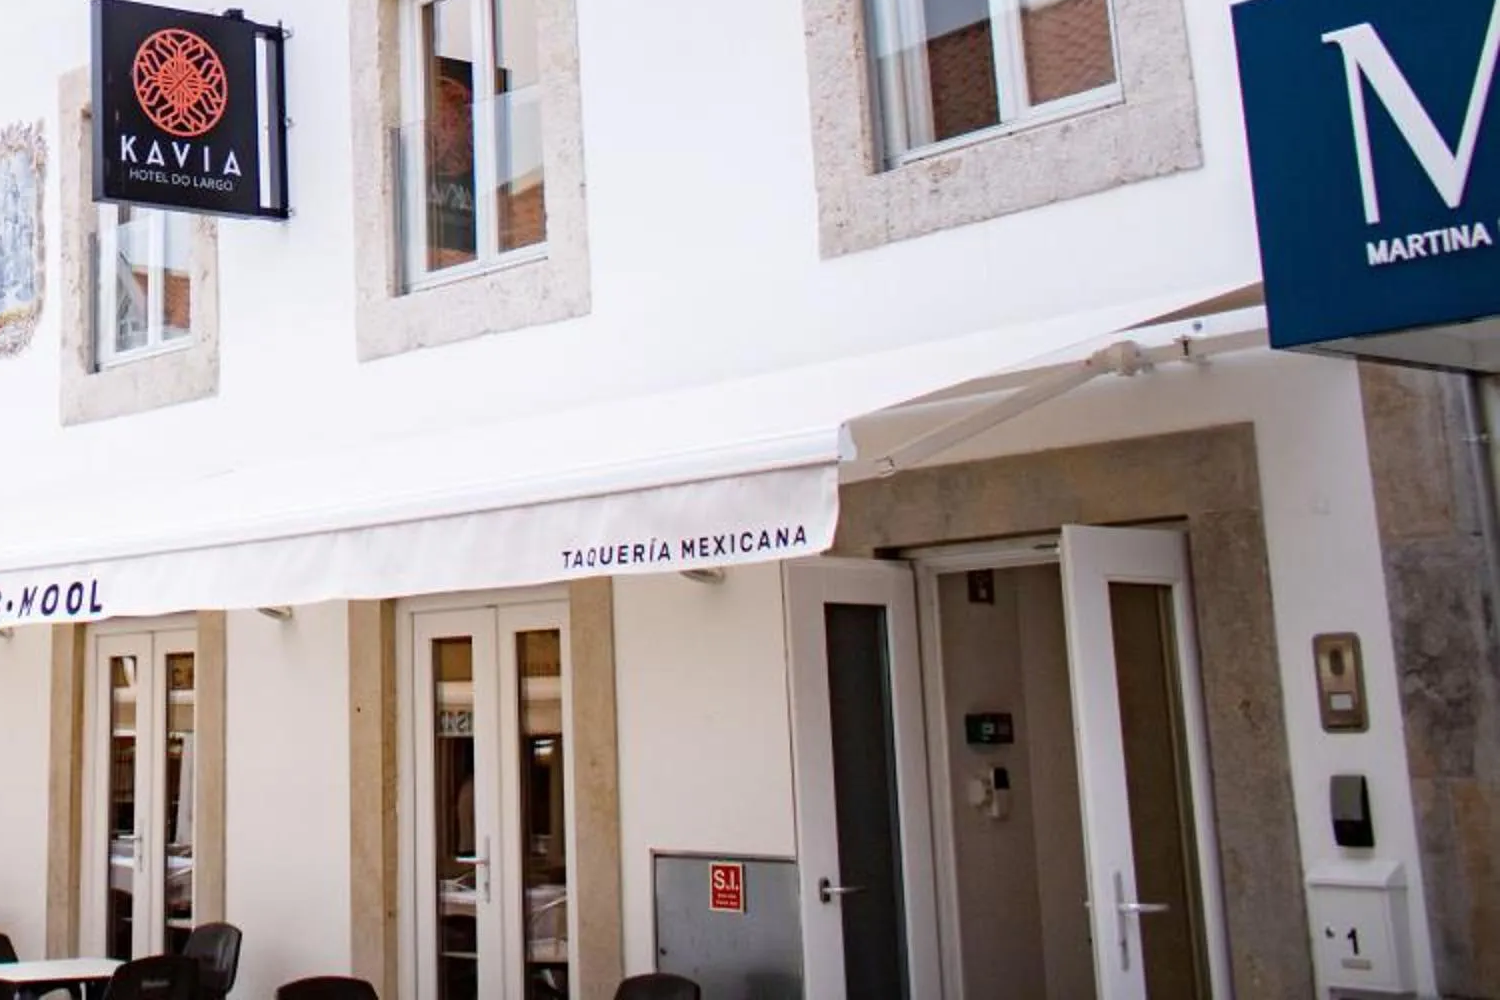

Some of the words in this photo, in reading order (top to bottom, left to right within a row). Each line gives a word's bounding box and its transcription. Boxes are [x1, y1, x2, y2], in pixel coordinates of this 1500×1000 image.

[120, 134, 242, 177] KAVIA
[129, 168, 168, 184] HOTEL
[171, 173, 190, 187] DO
[193, 175, 233, 191] LARGO
[1366, 221, 1493, 267] MARTINA
[562, 538, 671, 569] TAQUERÍA
[680, 525, 808, 559] MEXICANA
[1346, 926, 1360, 956] 1
